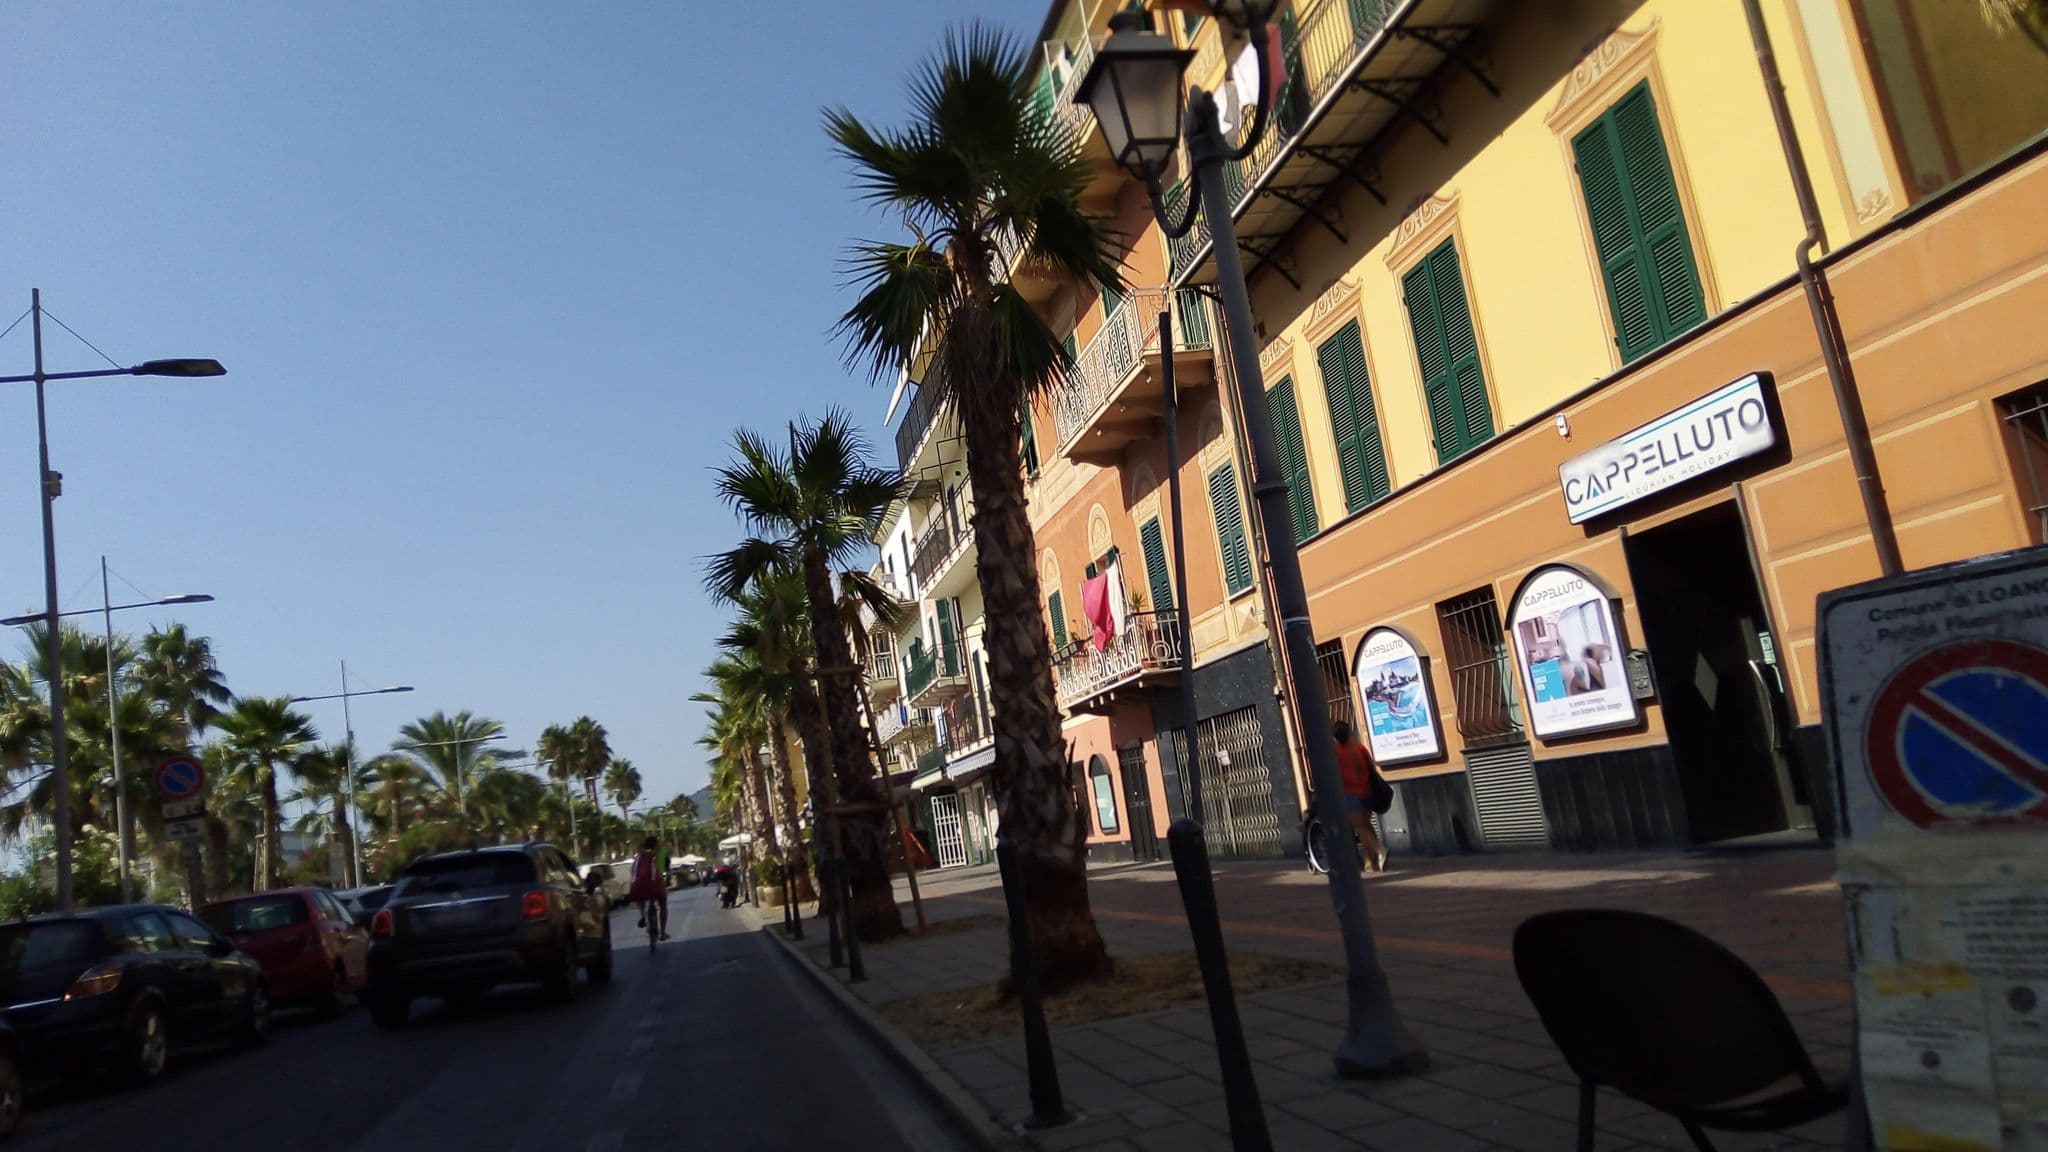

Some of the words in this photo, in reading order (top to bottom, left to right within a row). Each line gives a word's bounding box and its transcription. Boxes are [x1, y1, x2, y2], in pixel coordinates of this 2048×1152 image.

[1565, 398, 1765, 505] CAPPELLUTO
[1681, 450, 1730, 474] HOLIDAY
[1523, 578, 1584, 607] CAPPELLUTO
[1363, 639, 1404, 658] CAPPELLUTO
